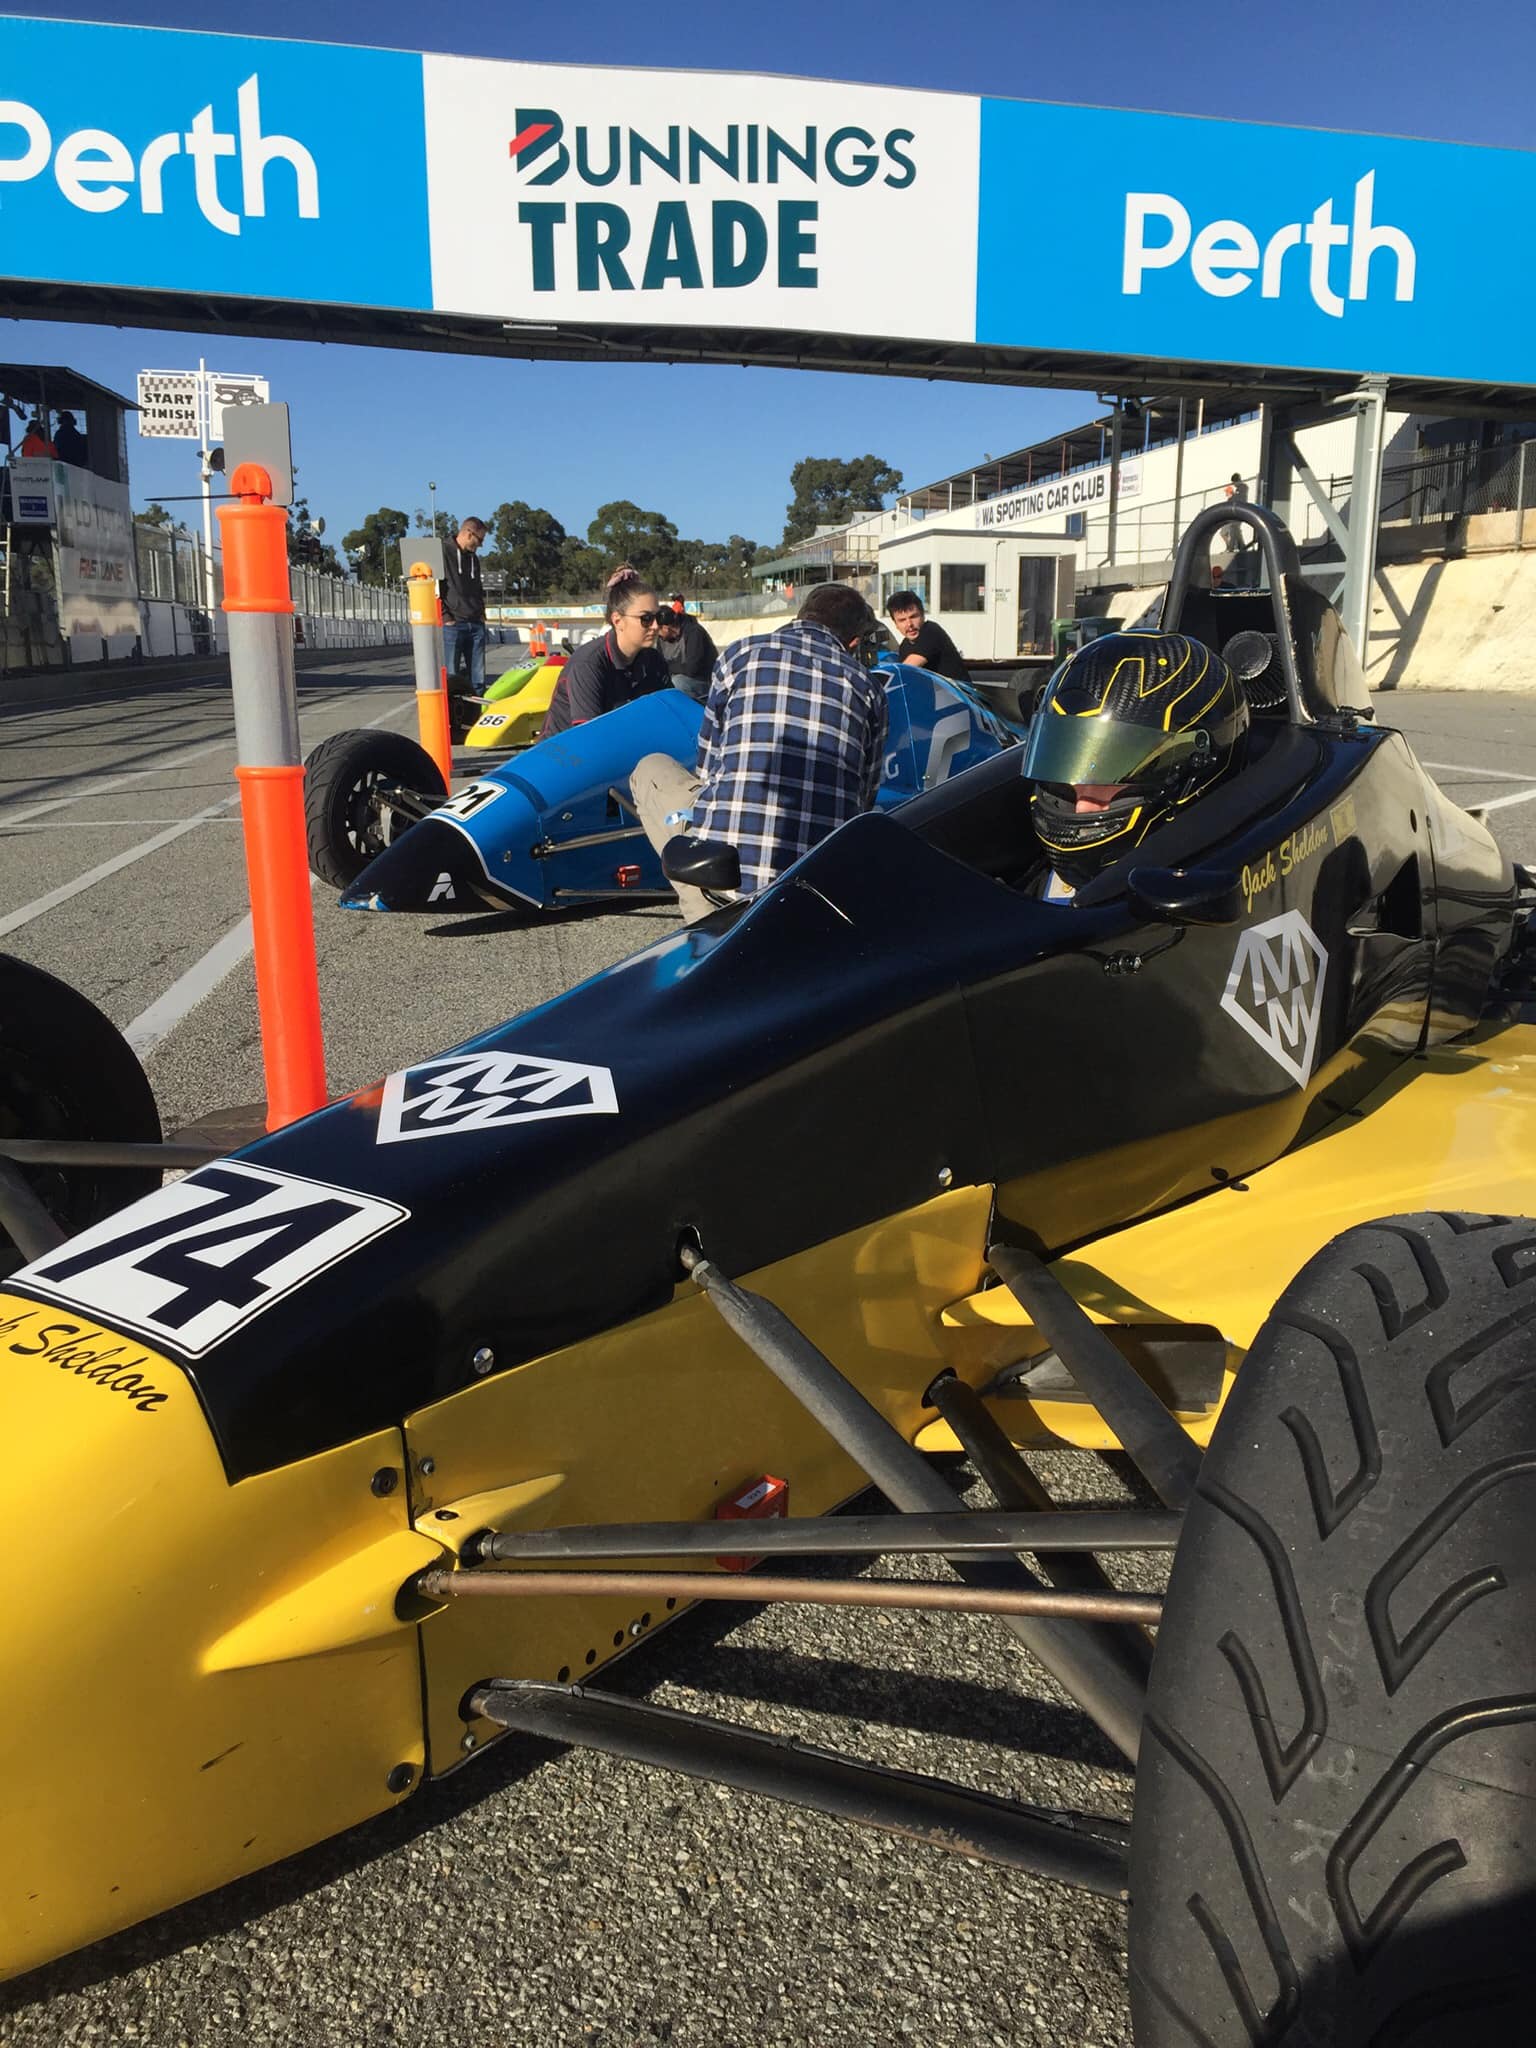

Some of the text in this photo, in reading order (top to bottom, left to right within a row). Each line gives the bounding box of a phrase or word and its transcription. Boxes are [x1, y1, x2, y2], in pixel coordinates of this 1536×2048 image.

[510, 107, 916, 190] BUNNINGS
[518, 199, 819, 292] TRADE
[1121, 168, 1416, 318] Perth
[143, 392, 193, 405] START
[143, 408, 196, 420] FINISH
[982, 505, 995, 526] WA
[996, 491, 1044, 523] SPORTING
[1046, 484, 1069, 510] CAR
[1072, 474, 1105, 504] CLUB
[479, 715, 506, 726] 86
[441, 785, 497, 815] 21
[1241, 822, 1329, 914] Jack Sheldon
[32, 1166, 364, 1330] 74
[8, 1323, 169, 1412] Sheldon
